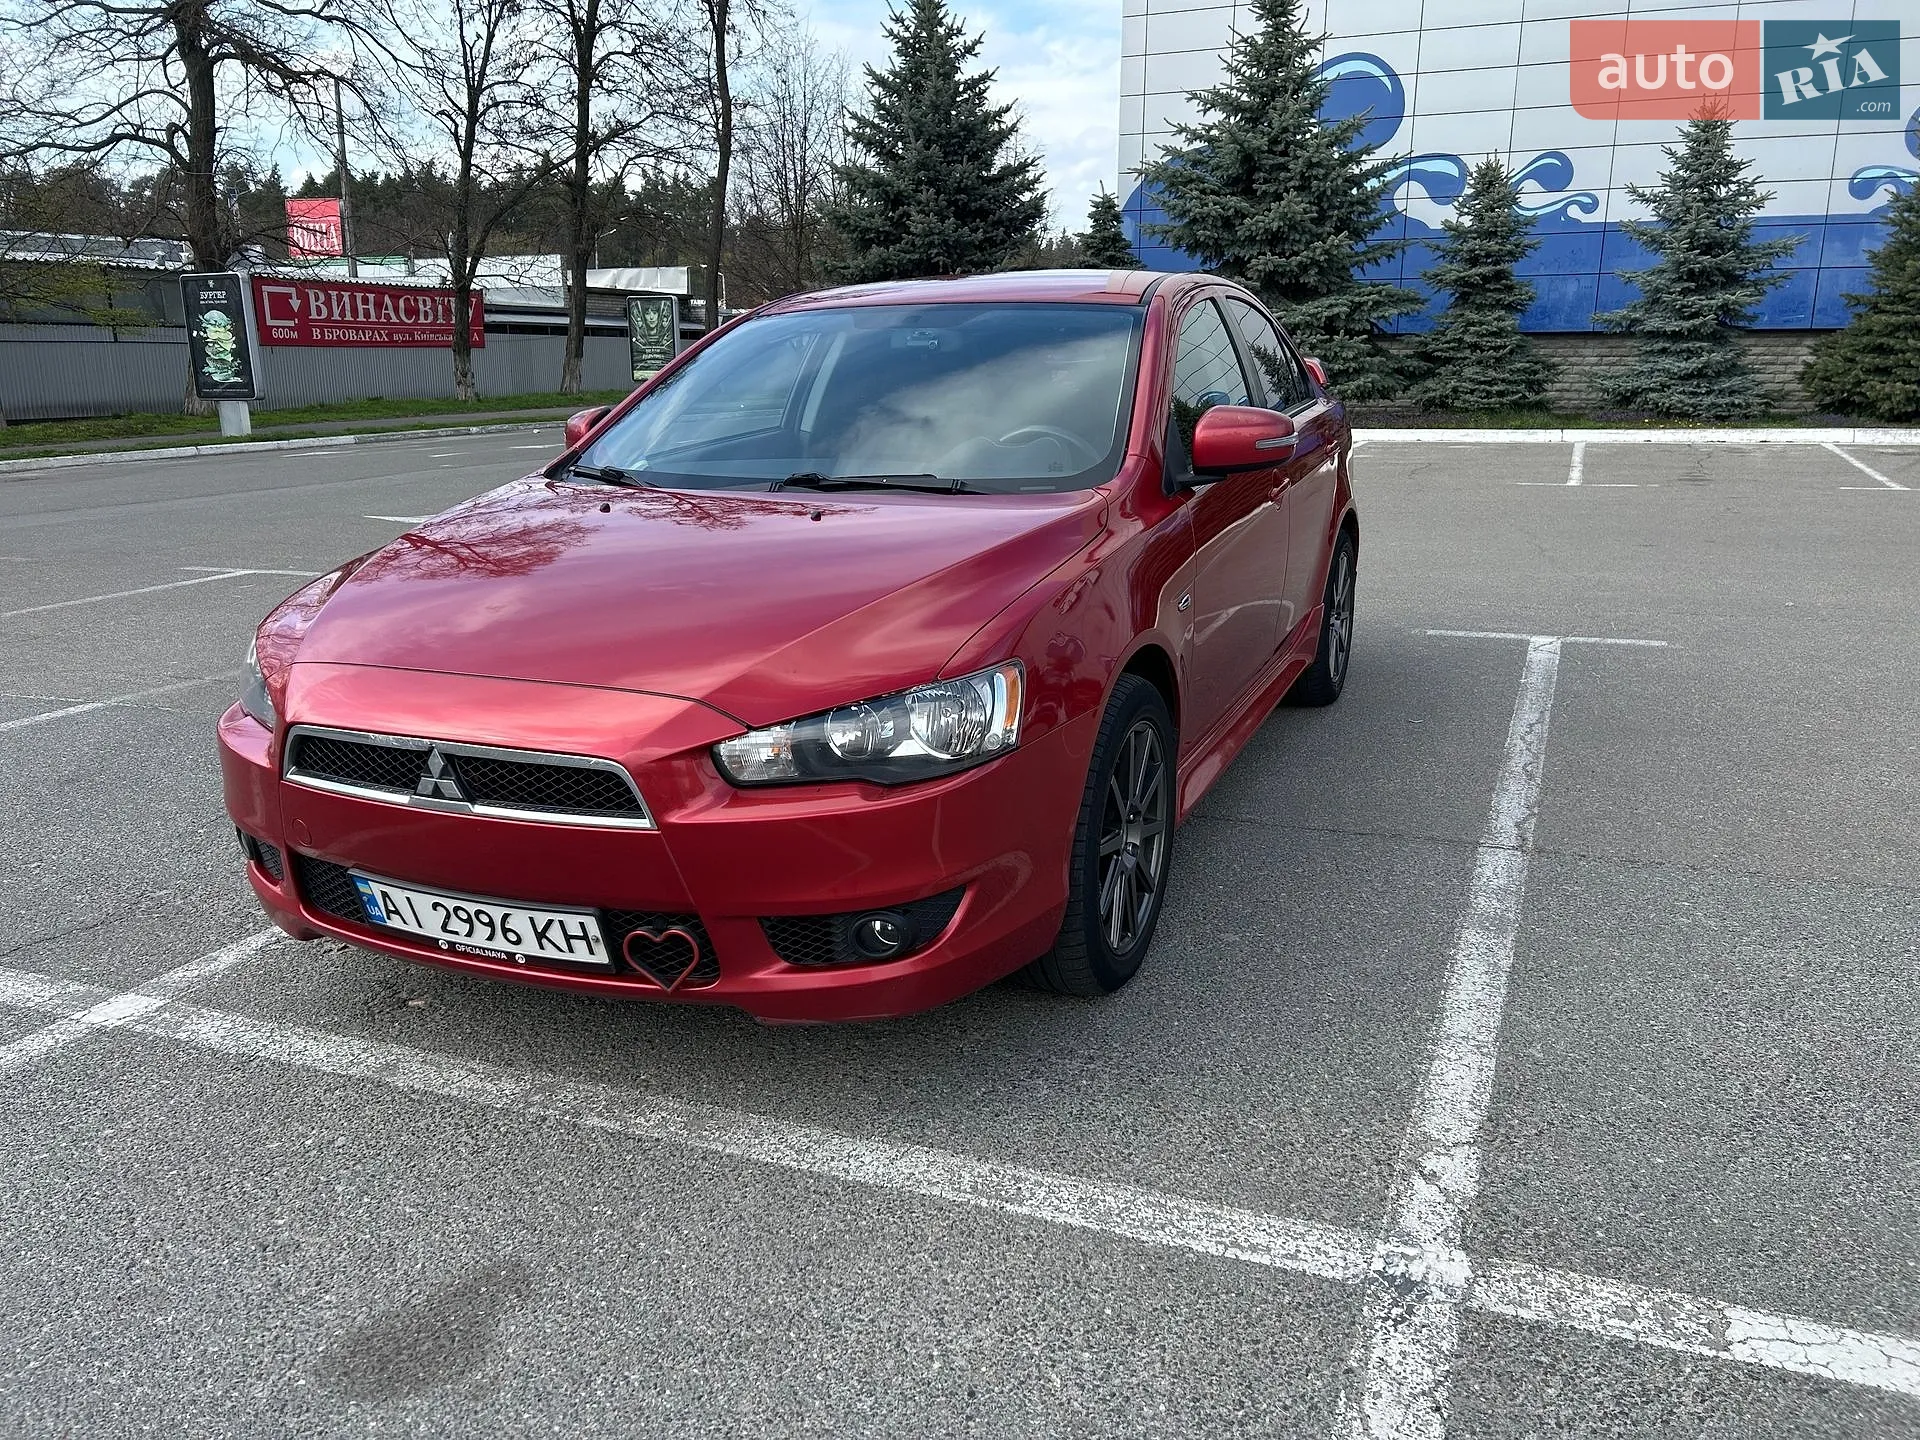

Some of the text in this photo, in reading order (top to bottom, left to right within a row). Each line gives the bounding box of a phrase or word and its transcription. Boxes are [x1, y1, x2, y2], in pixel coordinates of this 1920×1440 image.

[200, 290, 227, 300] БУРГЕР
[272, 327, 298, 339] 600м
[312, 327, 322, 340] В
[324, 327, 389, 341] БРОВАРАХ
[393, 332, 412, 343] вул.
[366, 904, 383, 917] UA
[380, 889, 596, 956] AI 2996 KH
[455, 943, 508, 960] OFICIALNAYA
